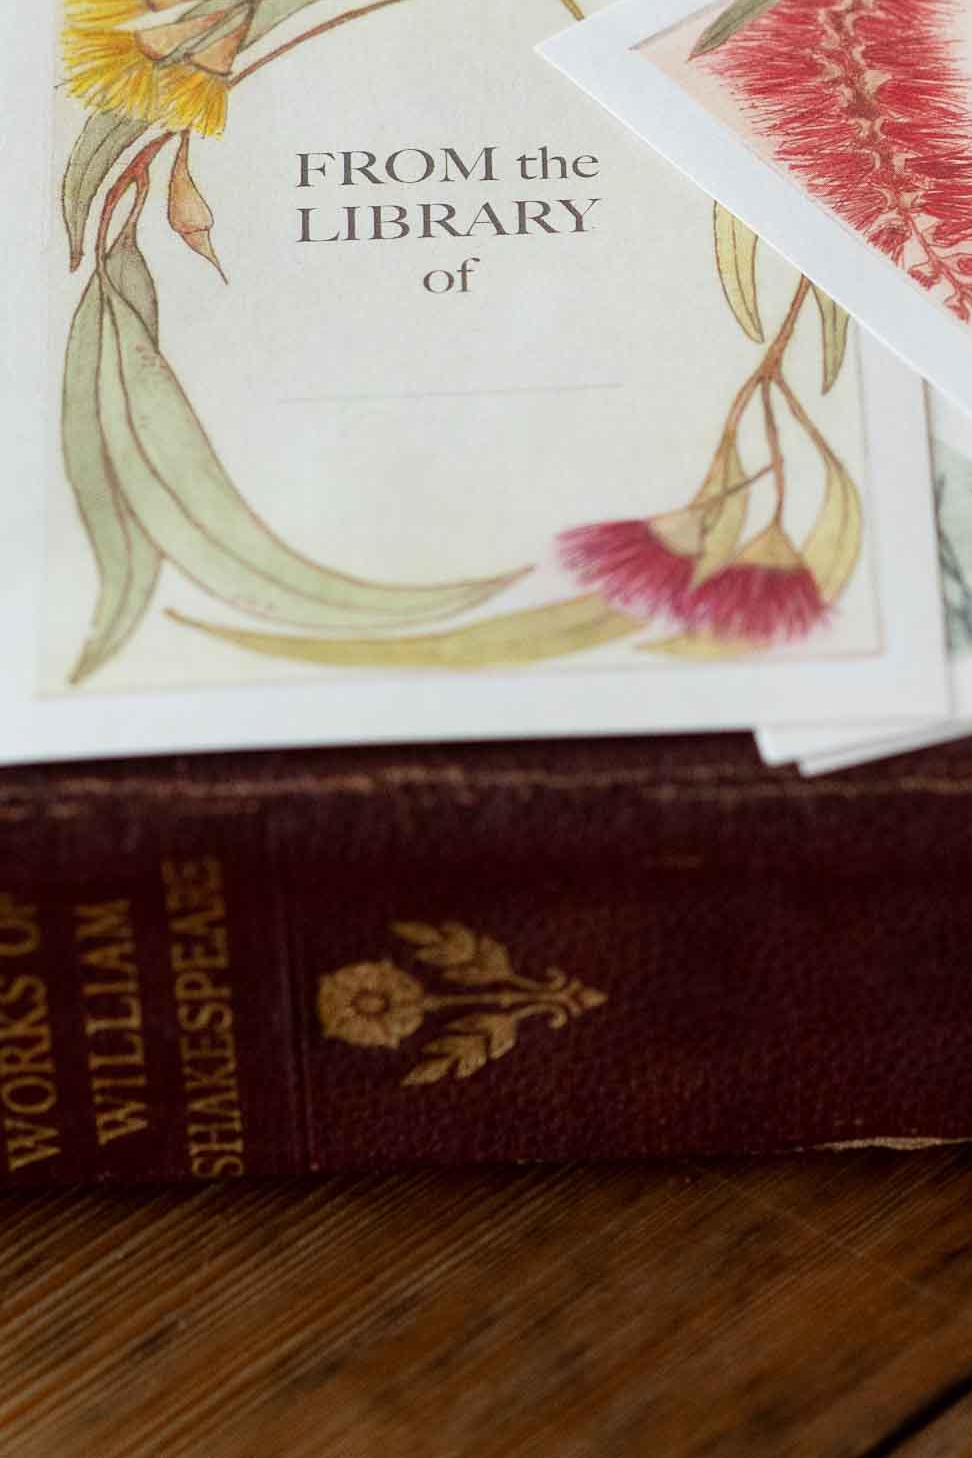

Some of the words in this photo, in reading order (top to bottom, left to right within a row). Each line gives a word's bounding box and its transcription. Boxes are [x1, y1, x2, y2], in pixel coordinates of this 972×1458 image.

[295, 145, 501, 188] FROM
[515, 145, 600, 181] the
[295, 197, 602, 243] LIBRARY
[422, 256, 481, 294] of
[0, 974, 61, 1171] WORKS
[75, 899, 148, 1146] WILLIAM
[162, 858, 244, 1178] SHAKESPEARE
